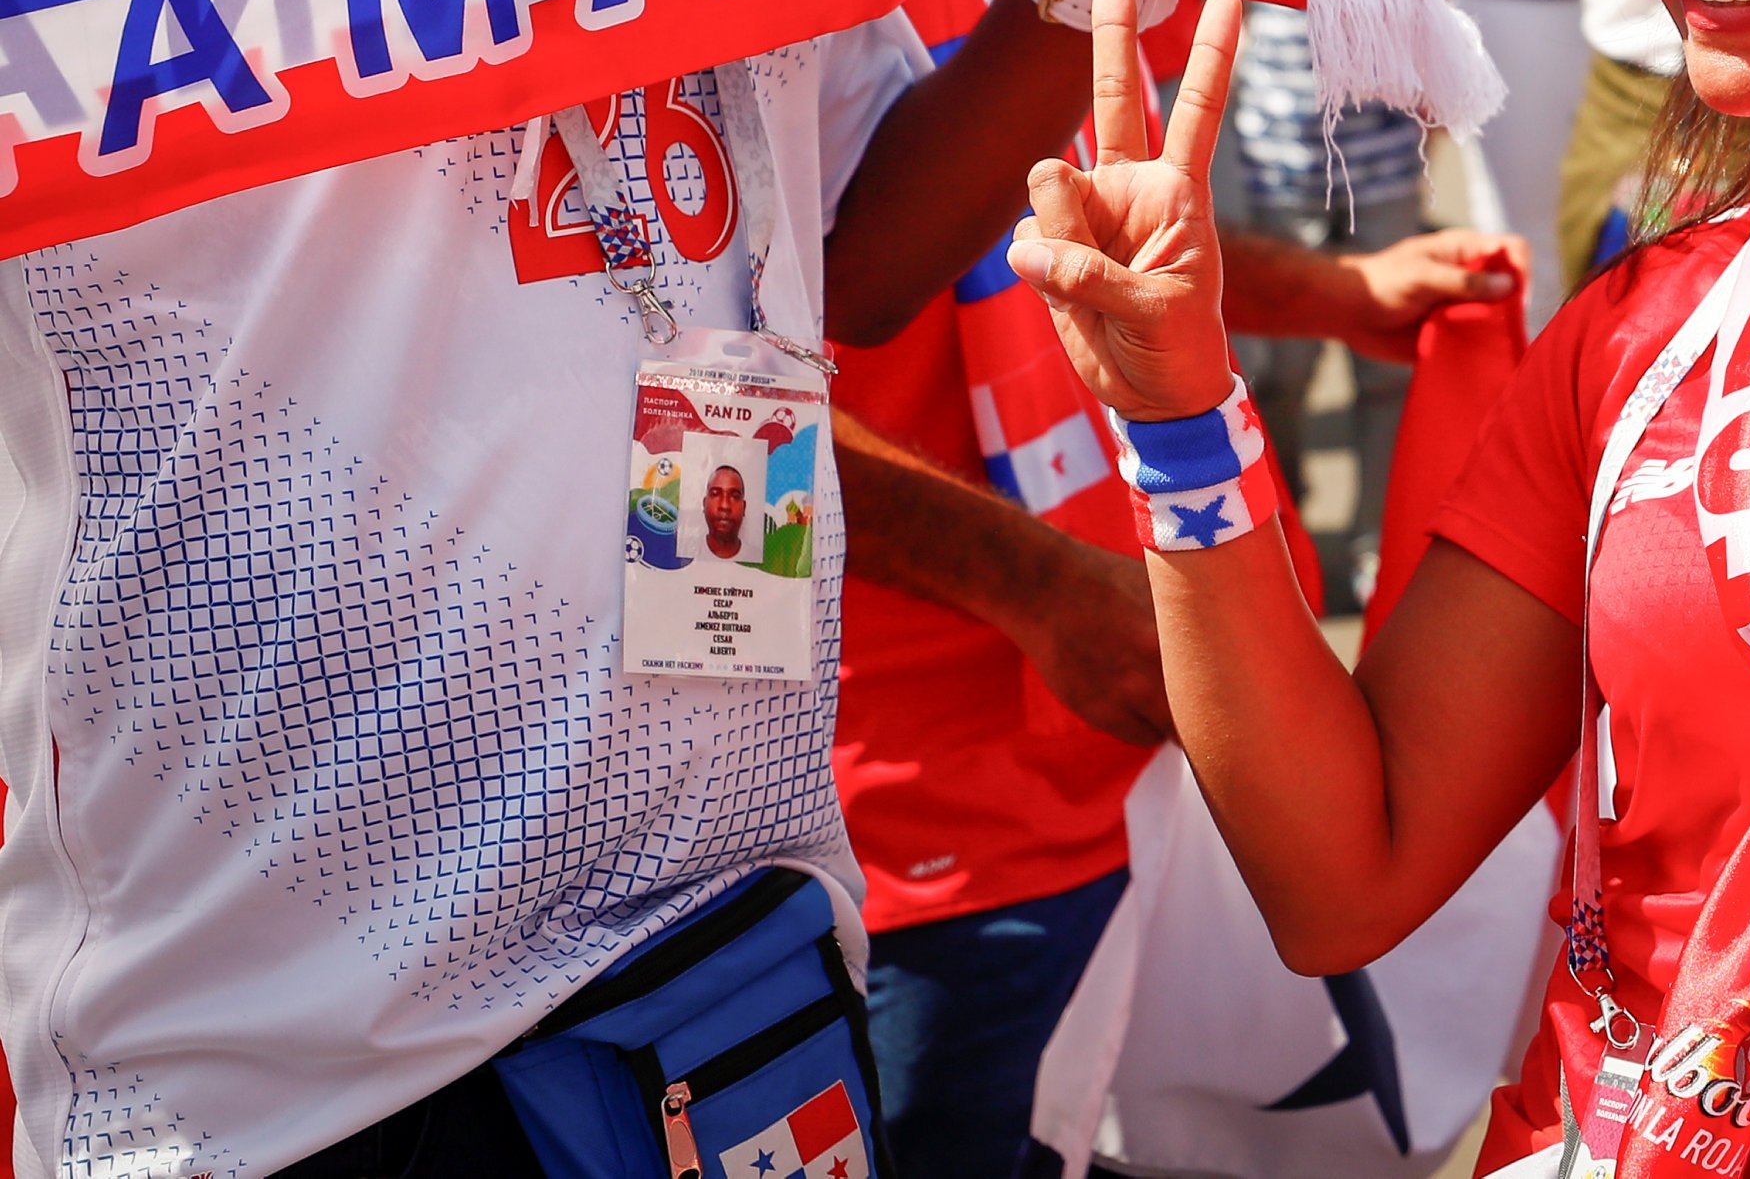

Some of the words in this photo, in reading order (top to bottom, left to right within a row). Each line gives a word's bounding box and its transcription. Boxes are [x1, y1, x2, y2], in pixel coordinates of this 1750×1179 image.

[704, 369, 717, 379] FIFA
[738, 373, 750, 383] CUP
[643, 396, 679, 408] ПАСПОРТ
[643, 407, 693, 420] БОЛЕЛЬЩИКА
[705, 404, 733, 420] FAN
[736, 408, 752, 421] ID
[713, 634, 733, 643] CESAR
[709, 646, 736, 656] ALBERTO
[1642, 1107, 1685, 1152] LA
